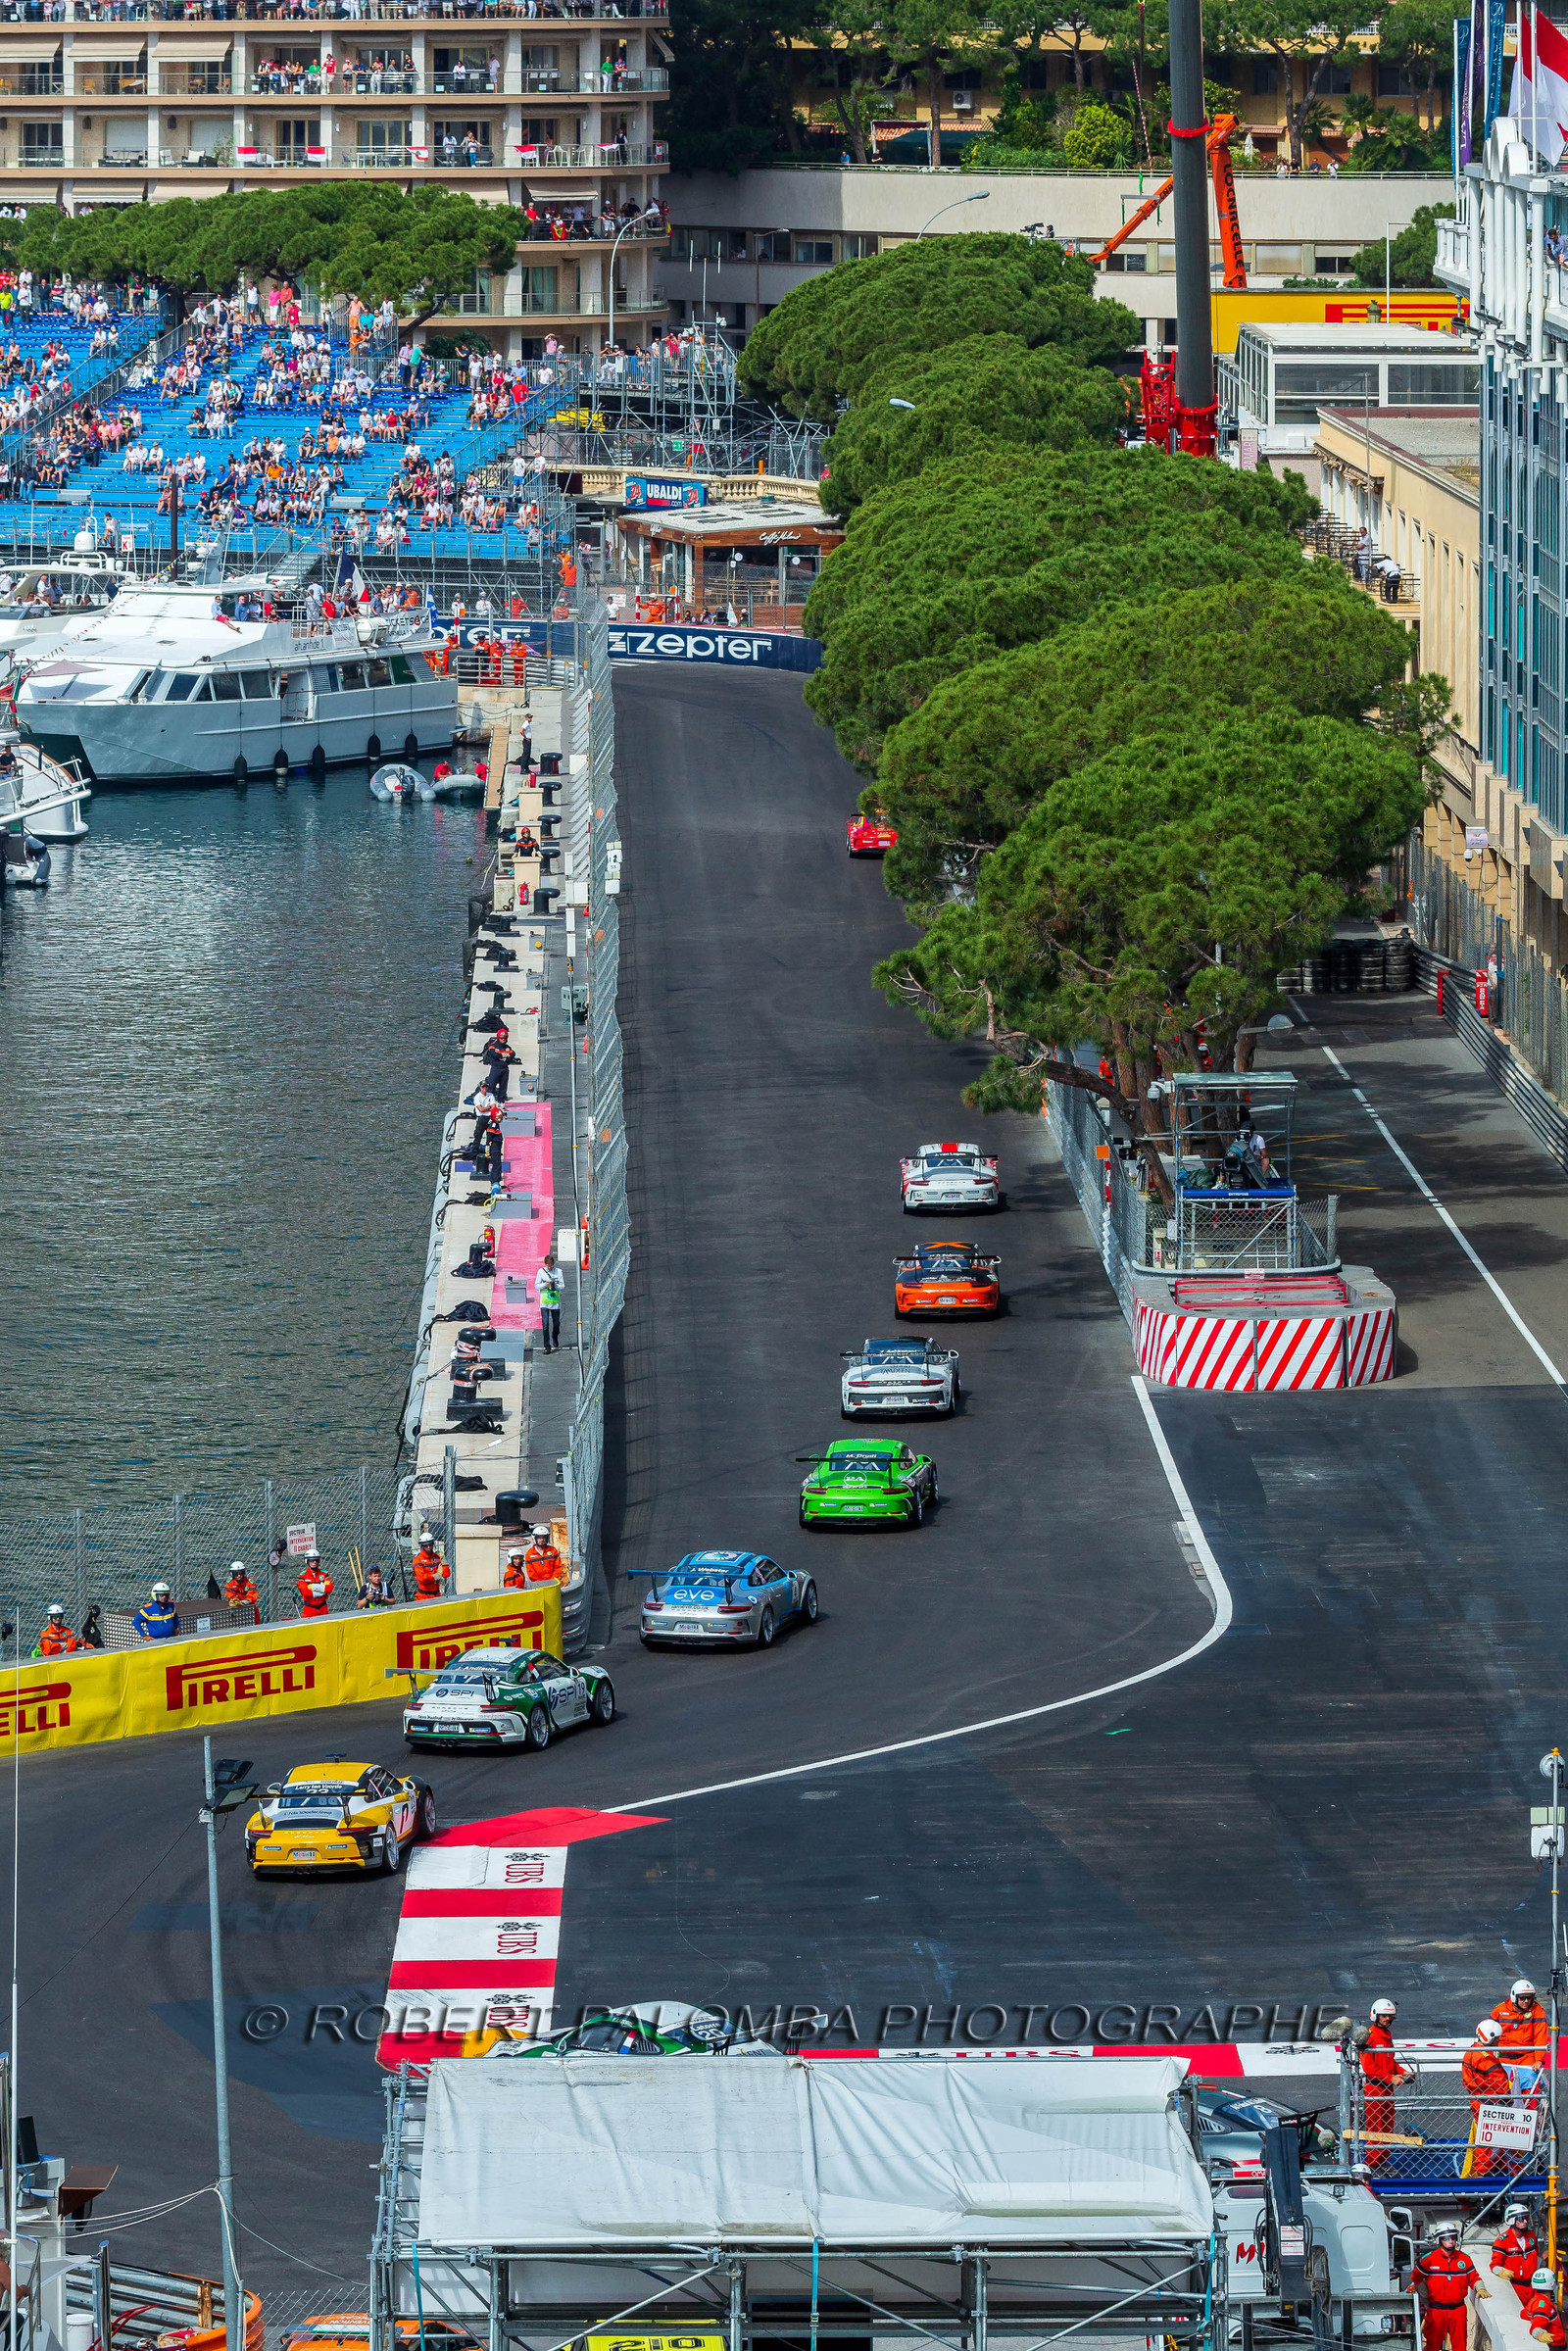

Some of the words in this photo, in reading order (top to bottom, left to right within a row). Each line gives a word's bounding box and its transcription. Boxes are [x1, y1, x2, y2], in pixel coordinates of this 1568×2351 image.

[647, 483, 682, 501] UBALDI
[636, 632, 772, 661] zepter
[674, 1589, 714, 1600] eve
[166, 1644, 317, 1711] PIRELLI
[559, 1685, 576, 1703] SPI
[578, 1682, 585, 1696] 19
[505, 1862, 545, 1884] UBS
[497, 1932, 538, 1955] UBS
[486, 2005, 530, 2029] UBS
[698, 2029, 725, 2039] 20
[1483, 2110, 1515, 2121] SECTEUR
[1523, 2114, 1532, 2123] 10
[1481, 2131, 1493, 2142] 10
[1483, 2123, 1530, 2134] INTERVENTION
